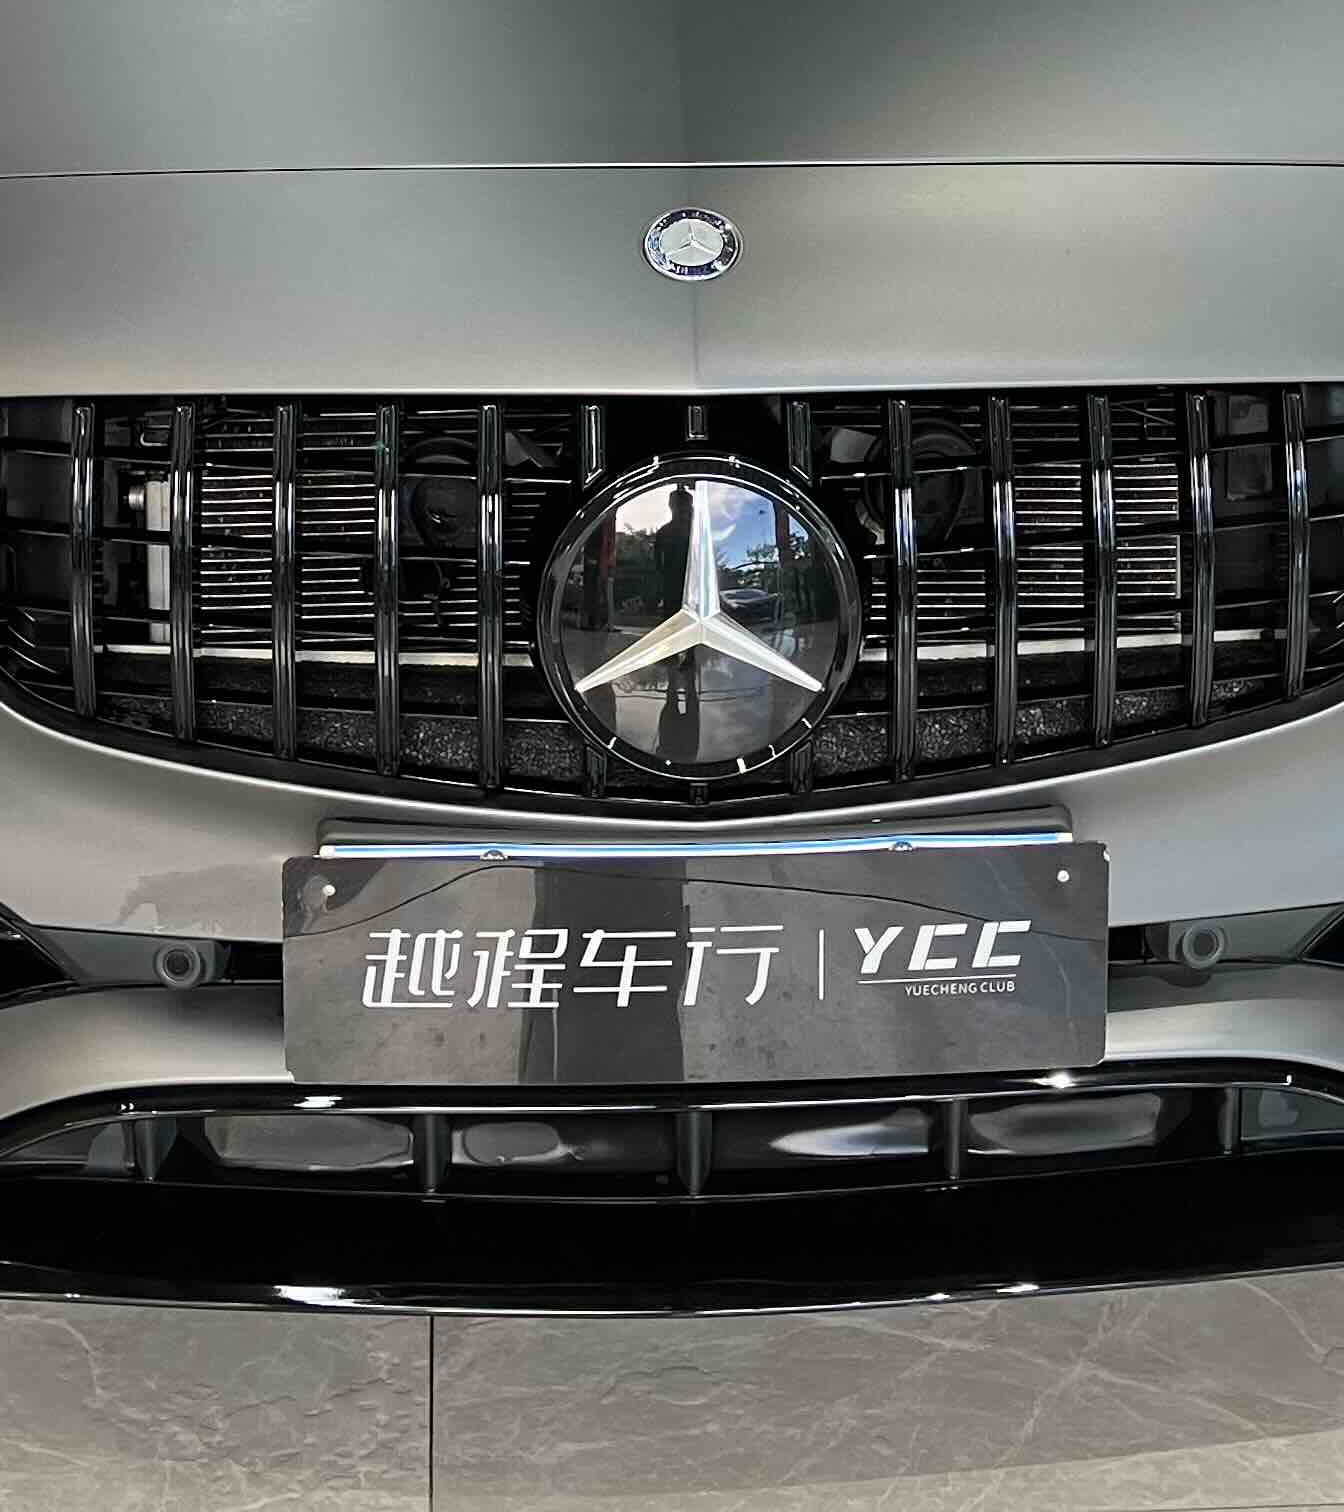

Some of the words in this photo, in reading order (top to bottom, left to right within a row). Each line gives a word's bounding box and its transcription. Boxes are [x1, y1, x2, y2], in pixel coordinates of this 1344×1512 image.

[362, 925, 784, 1008] 越程车行
[854, 920, 1032, 974] YCC
[904, 983, 978, 997] YUECHENG
[978, 981, 1016, 994] CLUB
